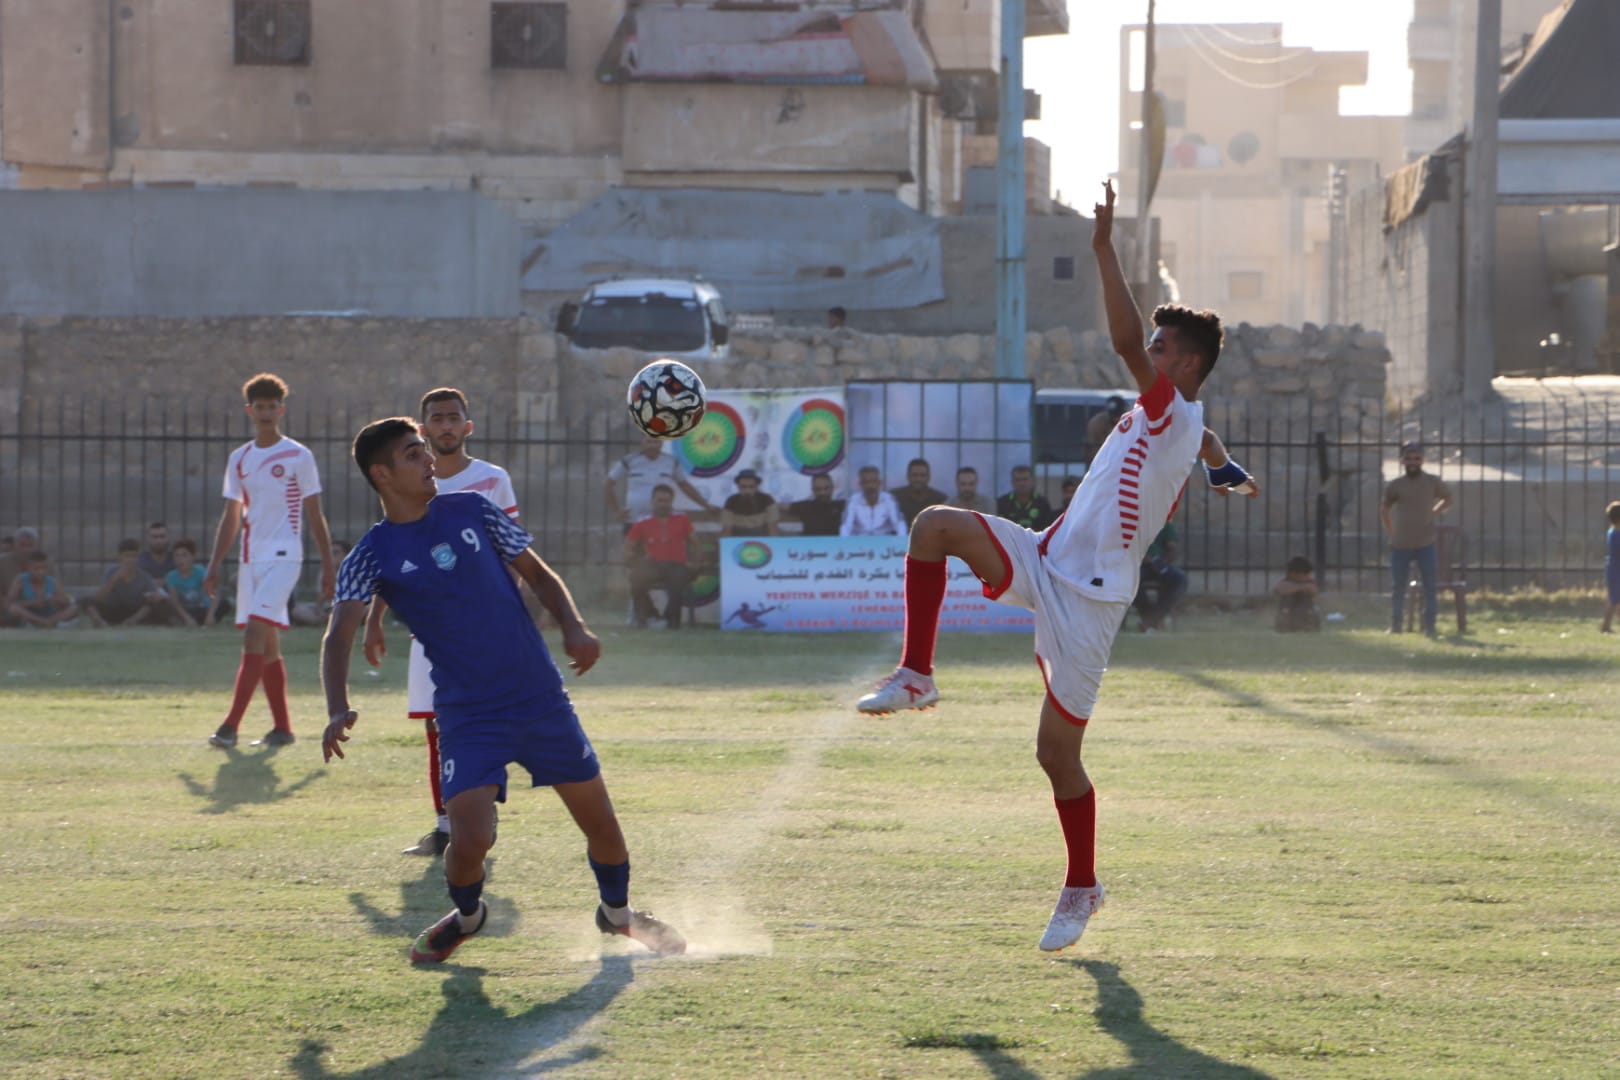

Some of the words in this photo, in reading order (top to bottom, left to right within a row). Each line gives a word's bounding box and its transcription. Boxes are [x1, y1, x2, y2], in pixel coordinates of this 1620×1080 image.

[461, 527, 481, 553] 9
[787, 547, 828, 561] سوريا
[814, 569, 853, 582] القدم
[444, 758, 455, 783] 9
